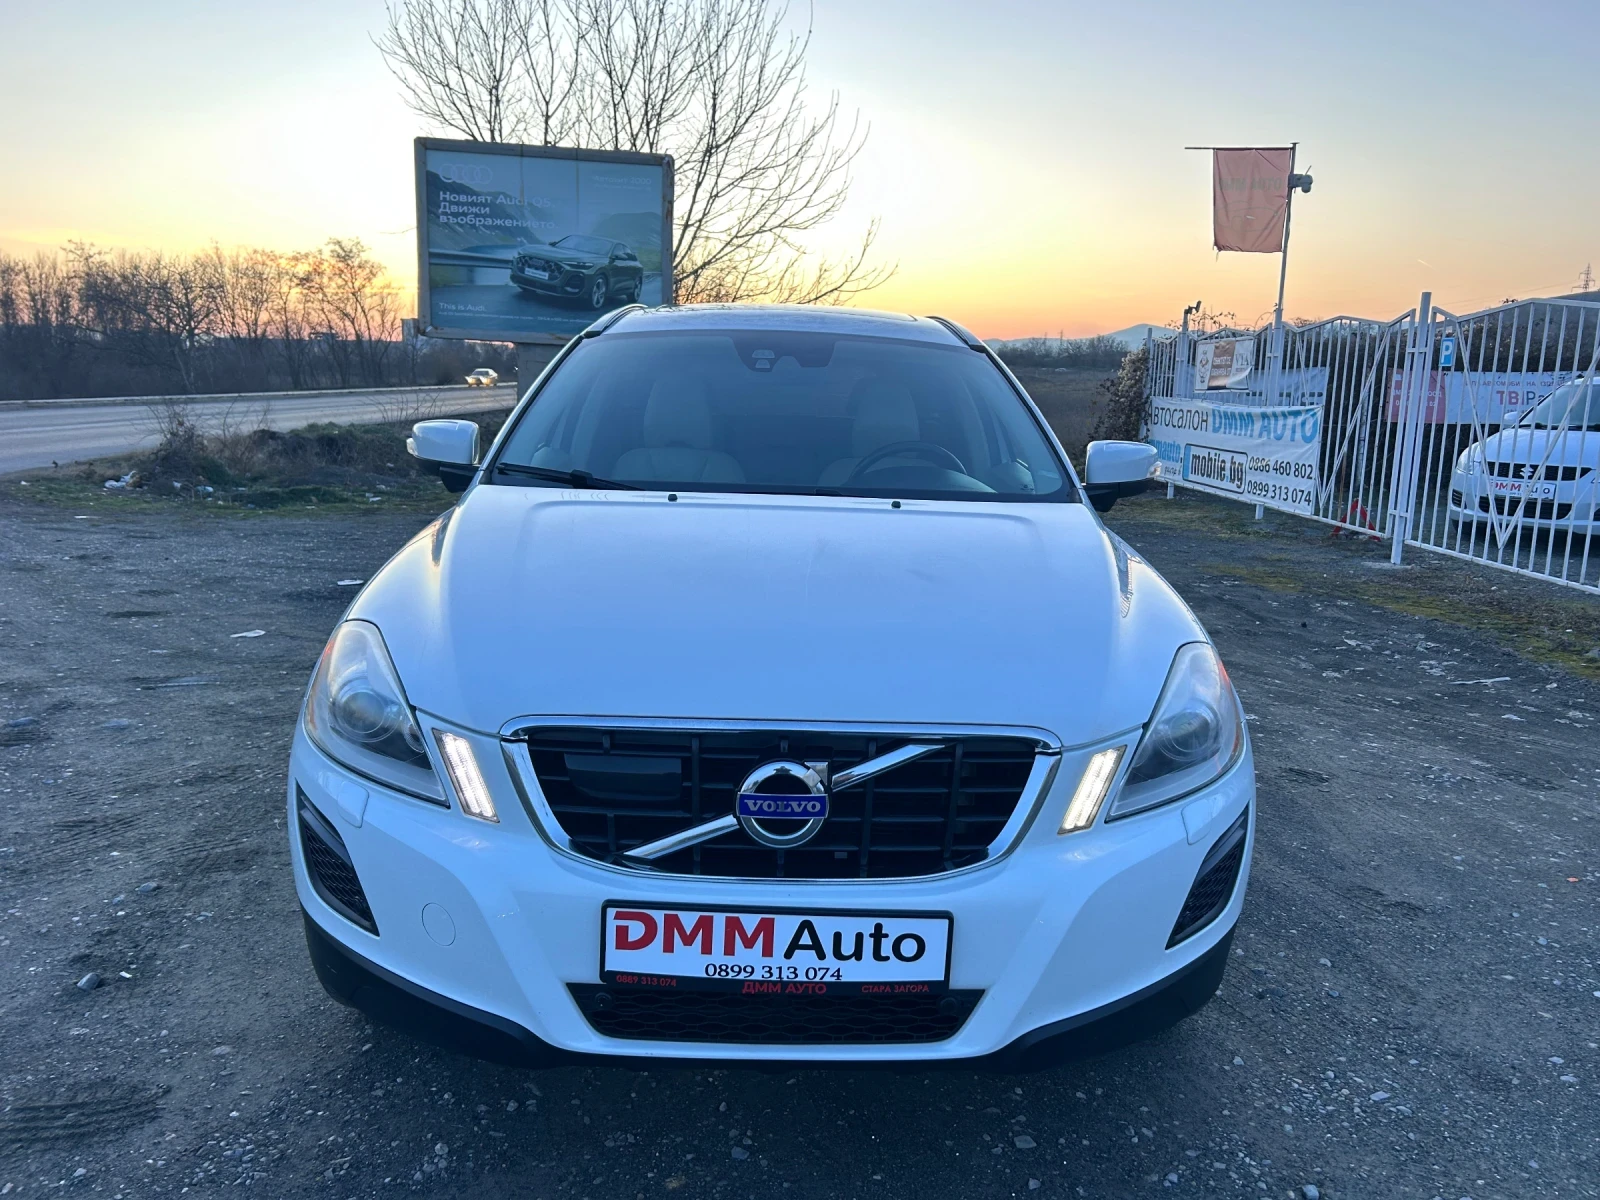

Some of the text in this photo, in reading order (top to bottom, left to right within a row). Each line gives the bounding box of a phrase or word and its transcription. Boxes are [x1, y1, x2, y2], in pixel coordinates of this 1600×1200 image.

[440, 191, 492, 204] Новият
[496, 195, 528, 206] Audi
[439, 202, 490, 214] Движи
[440, 215, 559, 229] въображението.
[439, 302, 456, 310] This
[458, 303, 465, 311] is
[1148, 403, 1319, 443] Автосалон DMM AUTO
[1190, 451, 1244, 489] mobile.bg
[1248, 456, 1313, 480] 0886 460 802
[1247, 480, 1312, 506] 0899 313 074
[744, 800, 821, 812] VOLVO
[705, 963, 842, 981] 0899 313 074
[641, 976, 657, 986] 313
[660, 978, 677, 987] 074
[742, 981, 827, 994] ДММ АУТО
[861, 984, 930, 993] СТАРА ЗАГОРА
